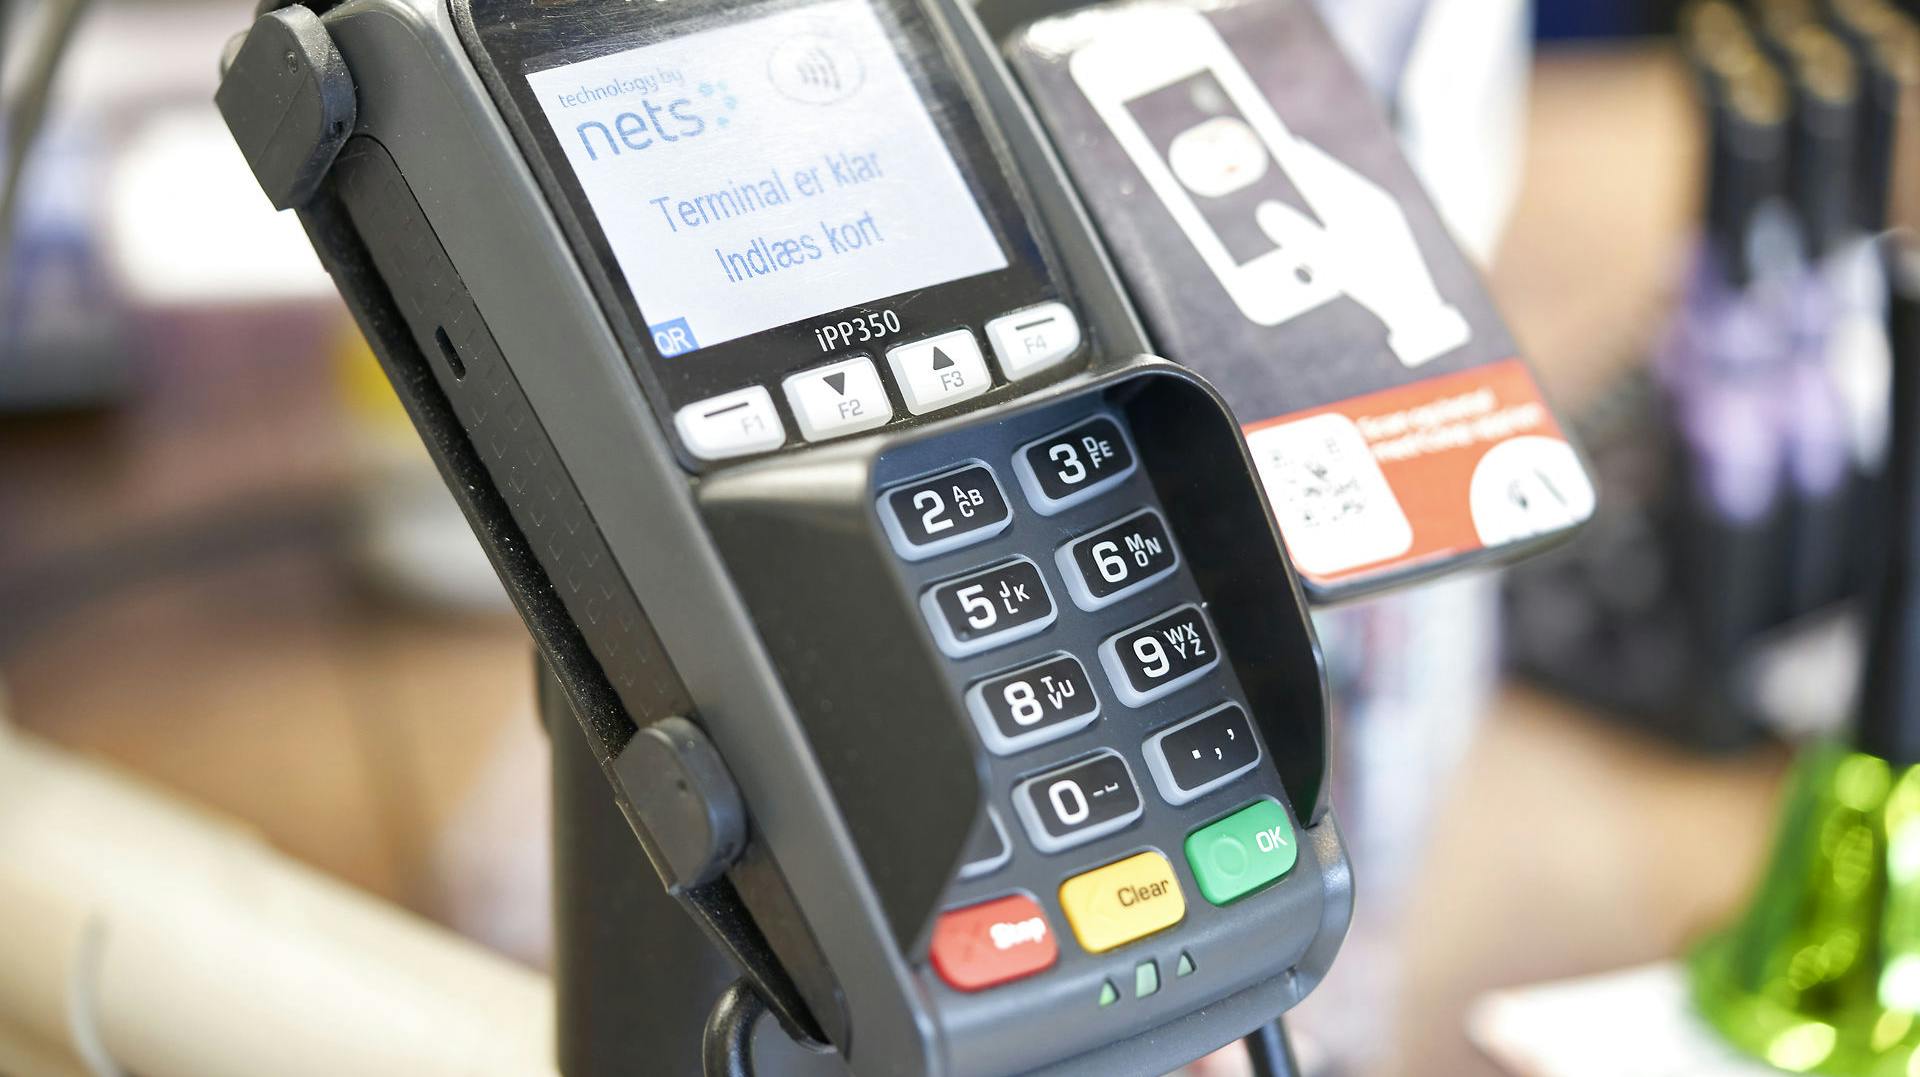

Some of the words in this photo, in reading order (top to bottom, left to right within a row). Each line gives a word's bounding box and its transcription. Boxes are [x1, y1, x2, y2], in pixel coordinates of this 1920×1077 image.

[558, 74, 659, 109] technology
[656, 66, 686, 87] by
[575, 97, 706, 162] nets
[649, 167, 792, 233] Terminal
[793, 166, 825, 197] er
[824, 150, 885, 188] klar
[714, 236, 823, 284] Indlæs
[820, 210, 885, 255] kort
[654, 326, 694, 353] QR
[816, 310, 901, 352] iPP350
[1024, 334, 1049, 356] F4
[939, 370, 966, 392] F3
[740, 413, 767, 435] F1
[837, 399, 865, 420] F2
[1047, 442, 1088, 485] 3
[912, 488, 955, 535] 2
[1091, 540, 1129, 584] 6
[955, 583, 998, 630] 5
[1132, 635, 1171, 679] 9
[1003, 679, 1045, 727] 8
[1048, 779, 1090, 826] 0
[1256, 826, 1287, 853] OK
[1117, 878, 1169, 909] Clear
